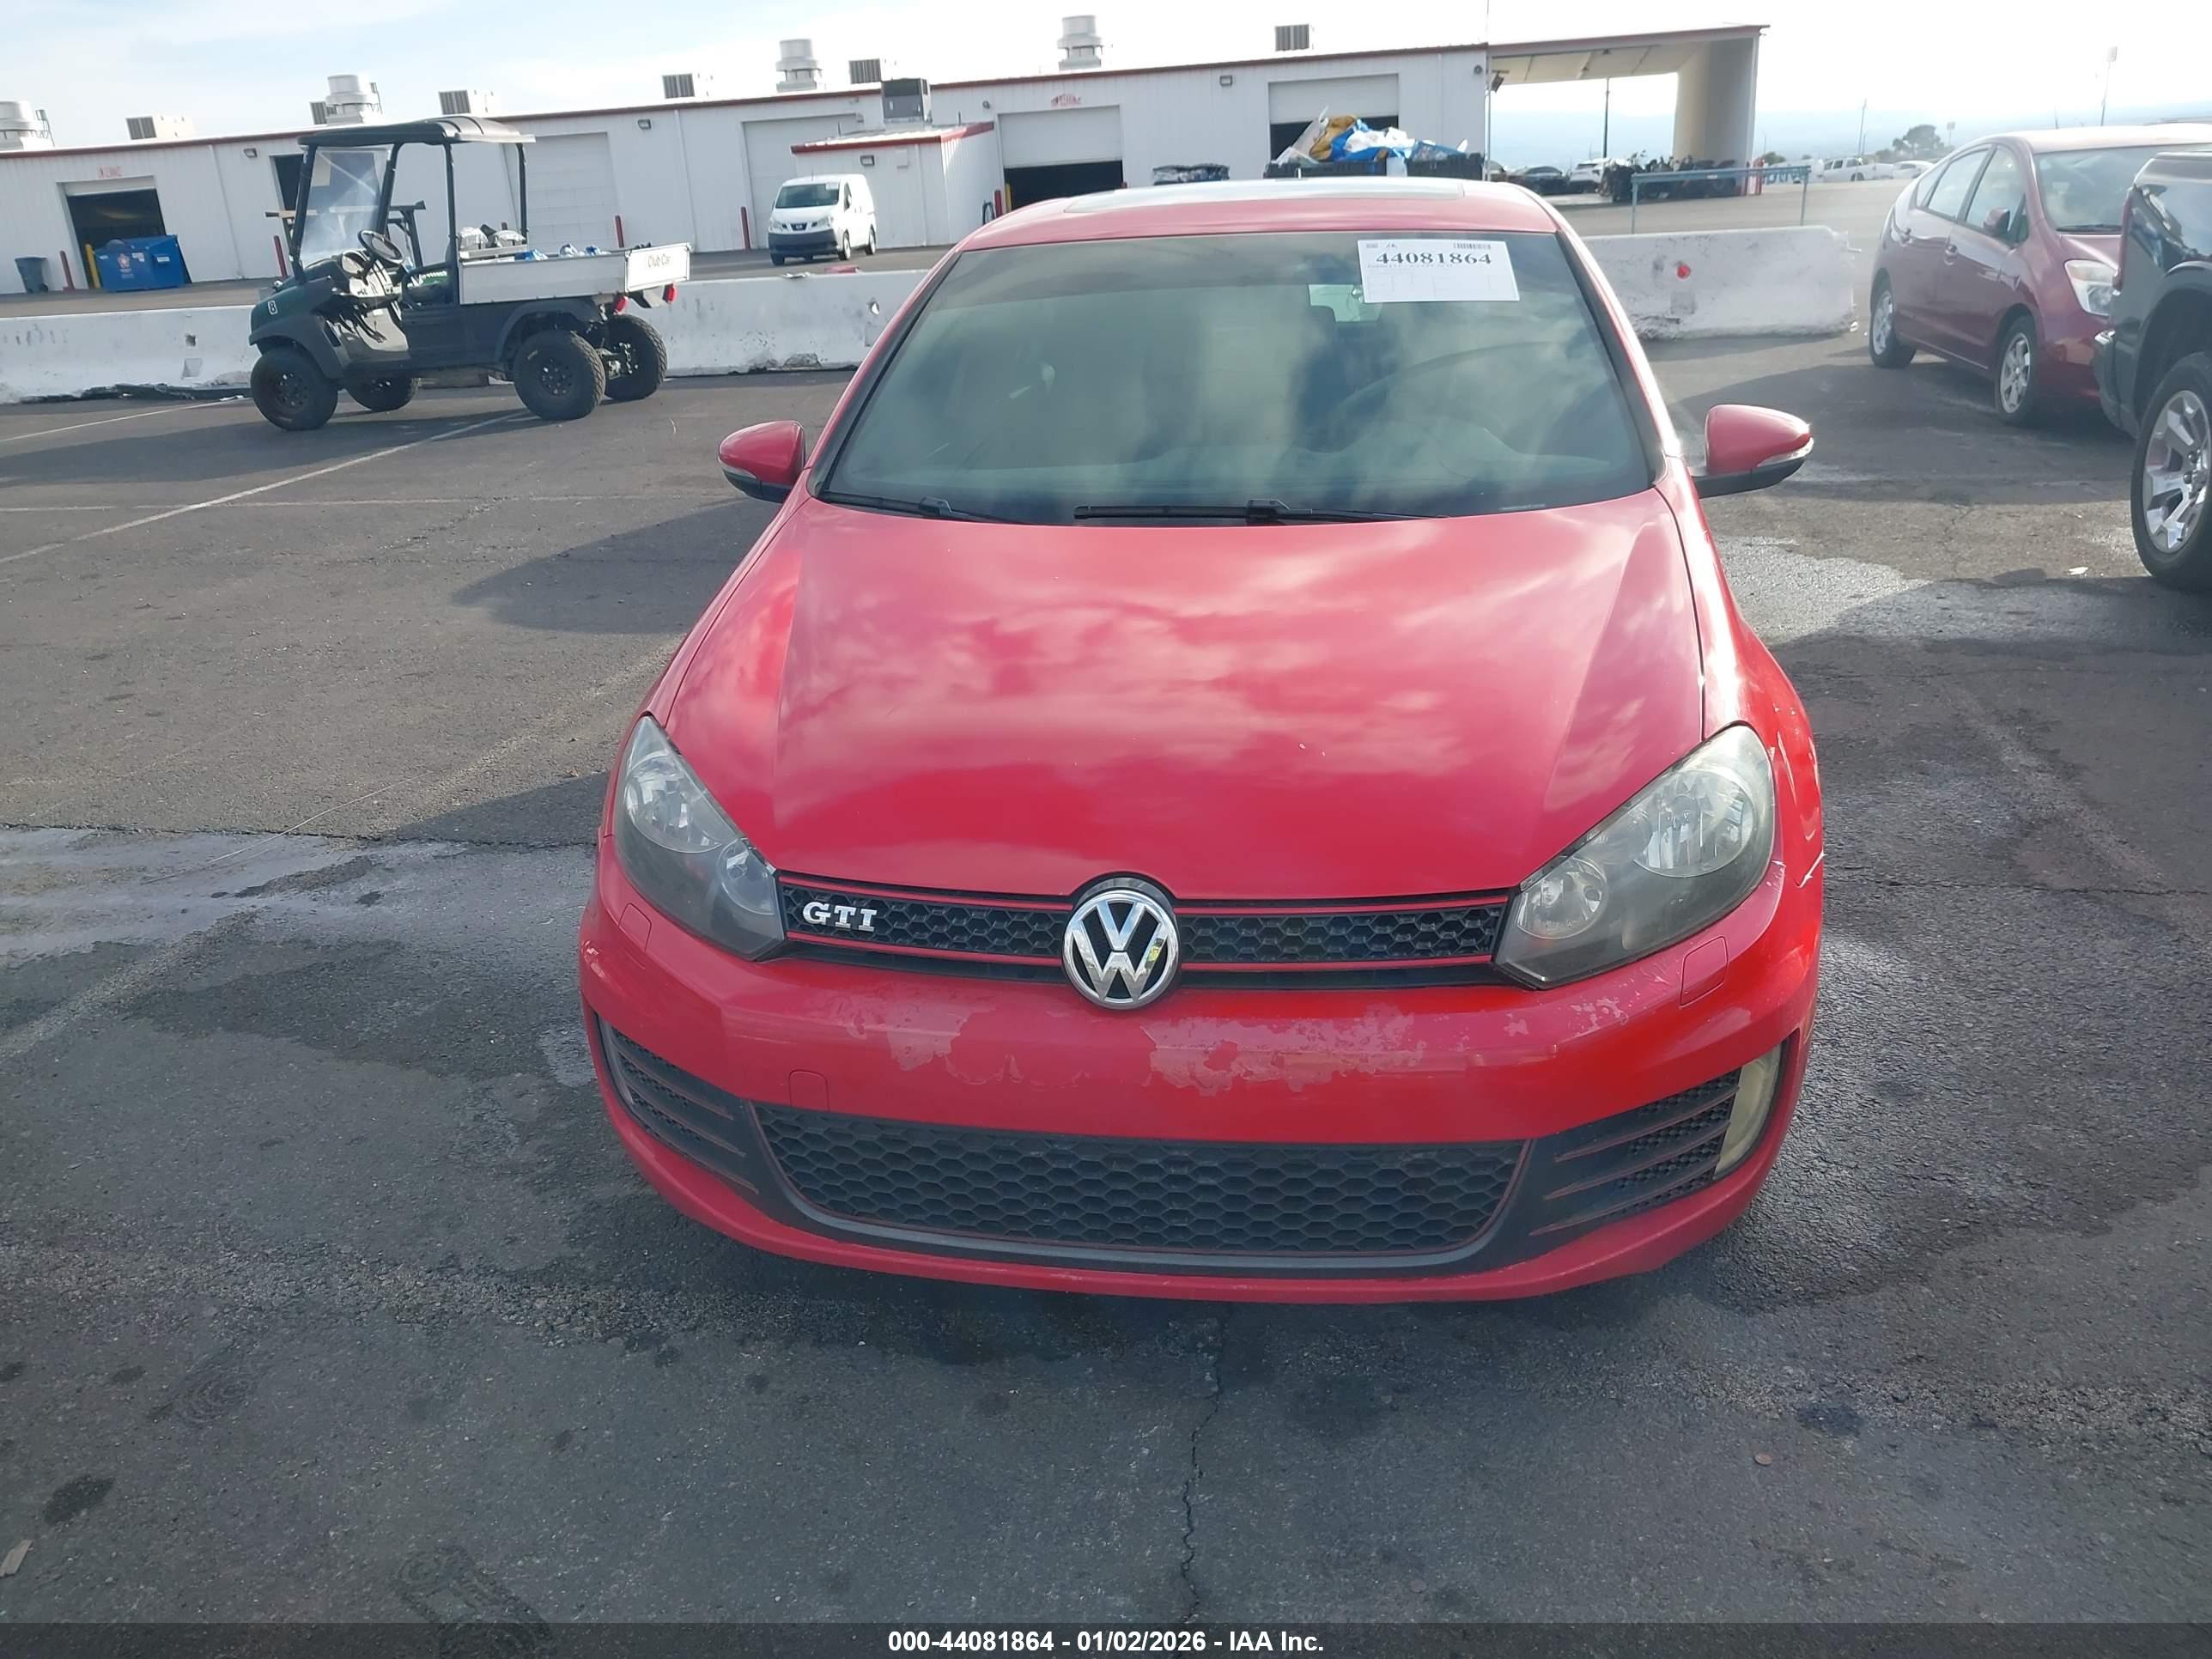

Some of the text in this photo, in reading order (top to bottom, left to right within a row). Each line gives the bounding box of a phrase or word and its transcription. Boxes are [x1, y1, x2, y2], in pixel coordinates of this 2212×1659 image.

[647, 253, 672, 268] Club Car
[1376, 252, 1492, 265] 44081864
[269, 301, 276, 313] 8
[803, 902, 878, 933] GTI
[1068, 893, 1175, 1004] VW
